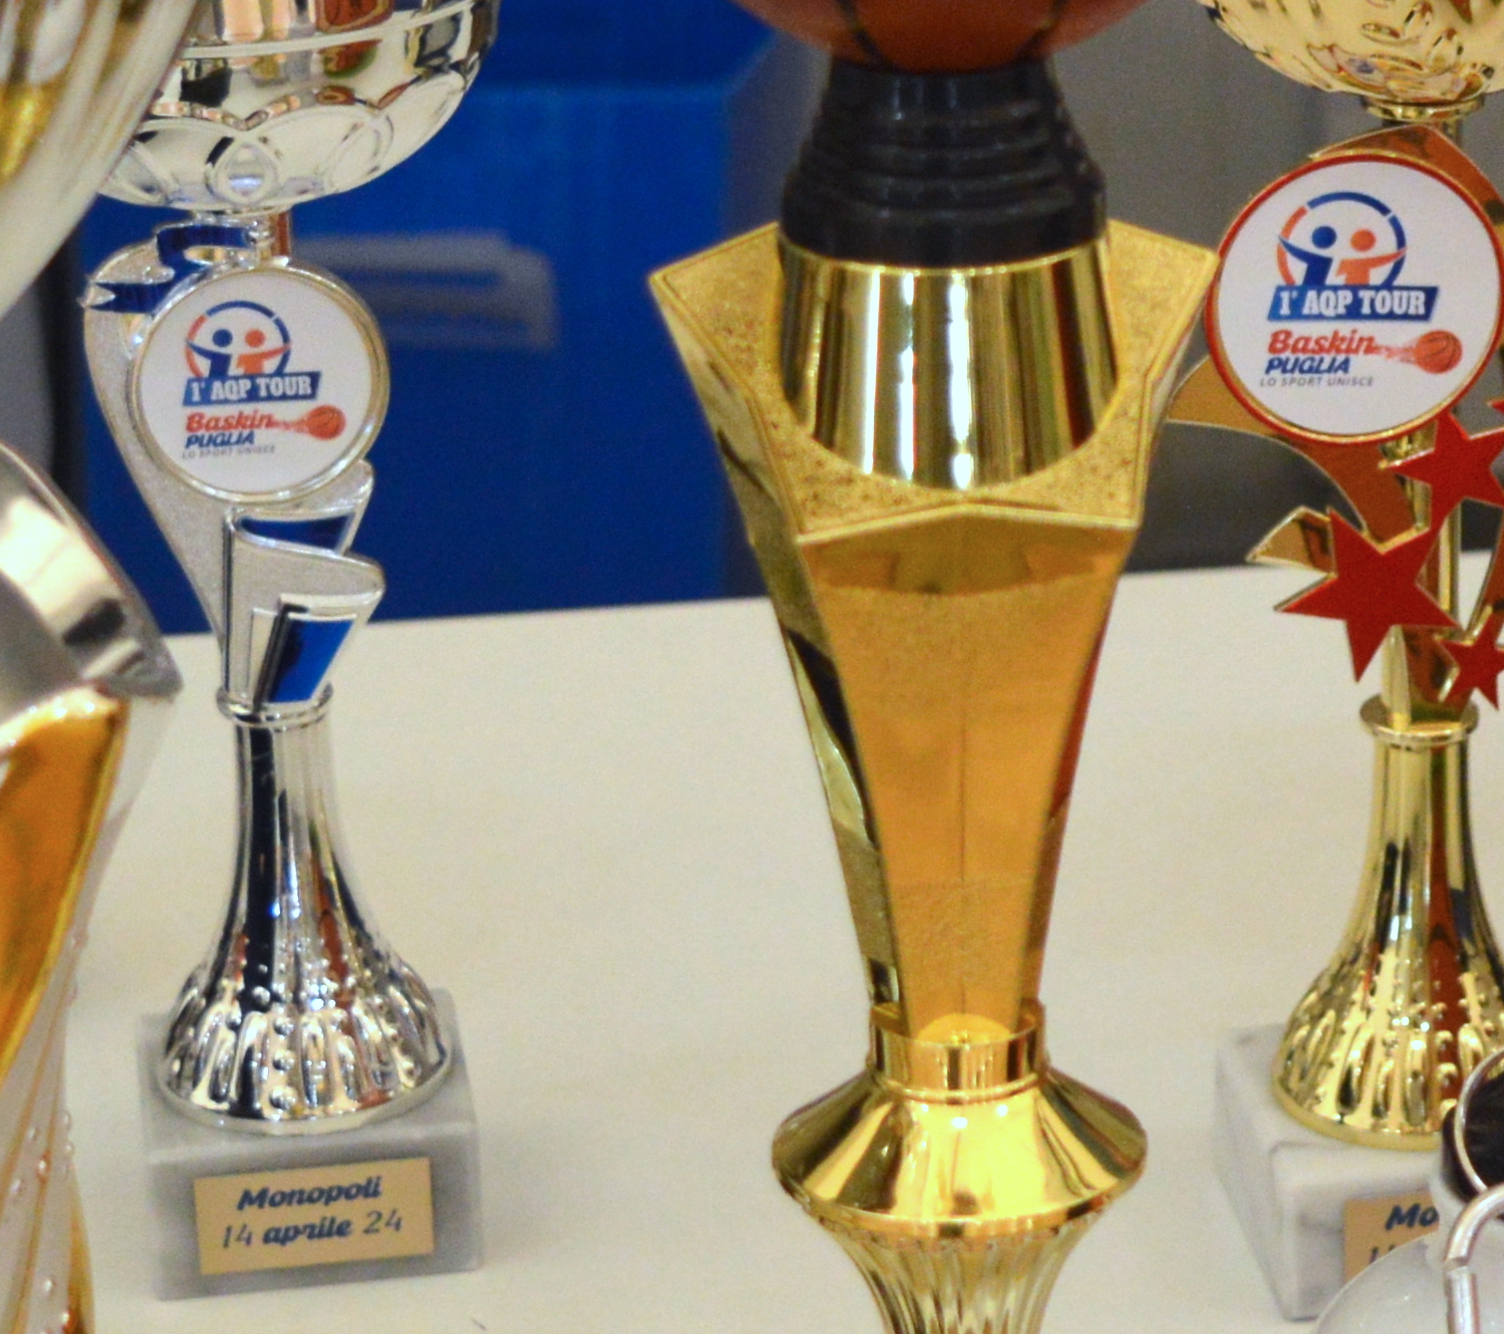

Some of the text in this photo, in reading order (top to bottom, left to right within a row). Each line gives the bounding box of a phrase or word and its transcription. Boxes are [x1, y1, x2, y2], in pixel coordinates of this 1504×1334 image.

[1304, 289, 1353, 317] AQP
[1358, 289, 1426, 315] TOUR
[1267, 328, 1377, 356] Baskin
[1264, 356, 1350, 376] PUGLIA
[211, 378, 252, 402] AQP
[256, 375, 312, 397] TOUR
[1260, 377, 1375, 387] LO SPORT UNISCE
[185, 409, 276, 434] Baskin
[184, 430, 256, 450] PUGLIA
[236, 1175, 383, 1211] Monopoli
[222, 1208, 403, 1249] 14 aprile 24
